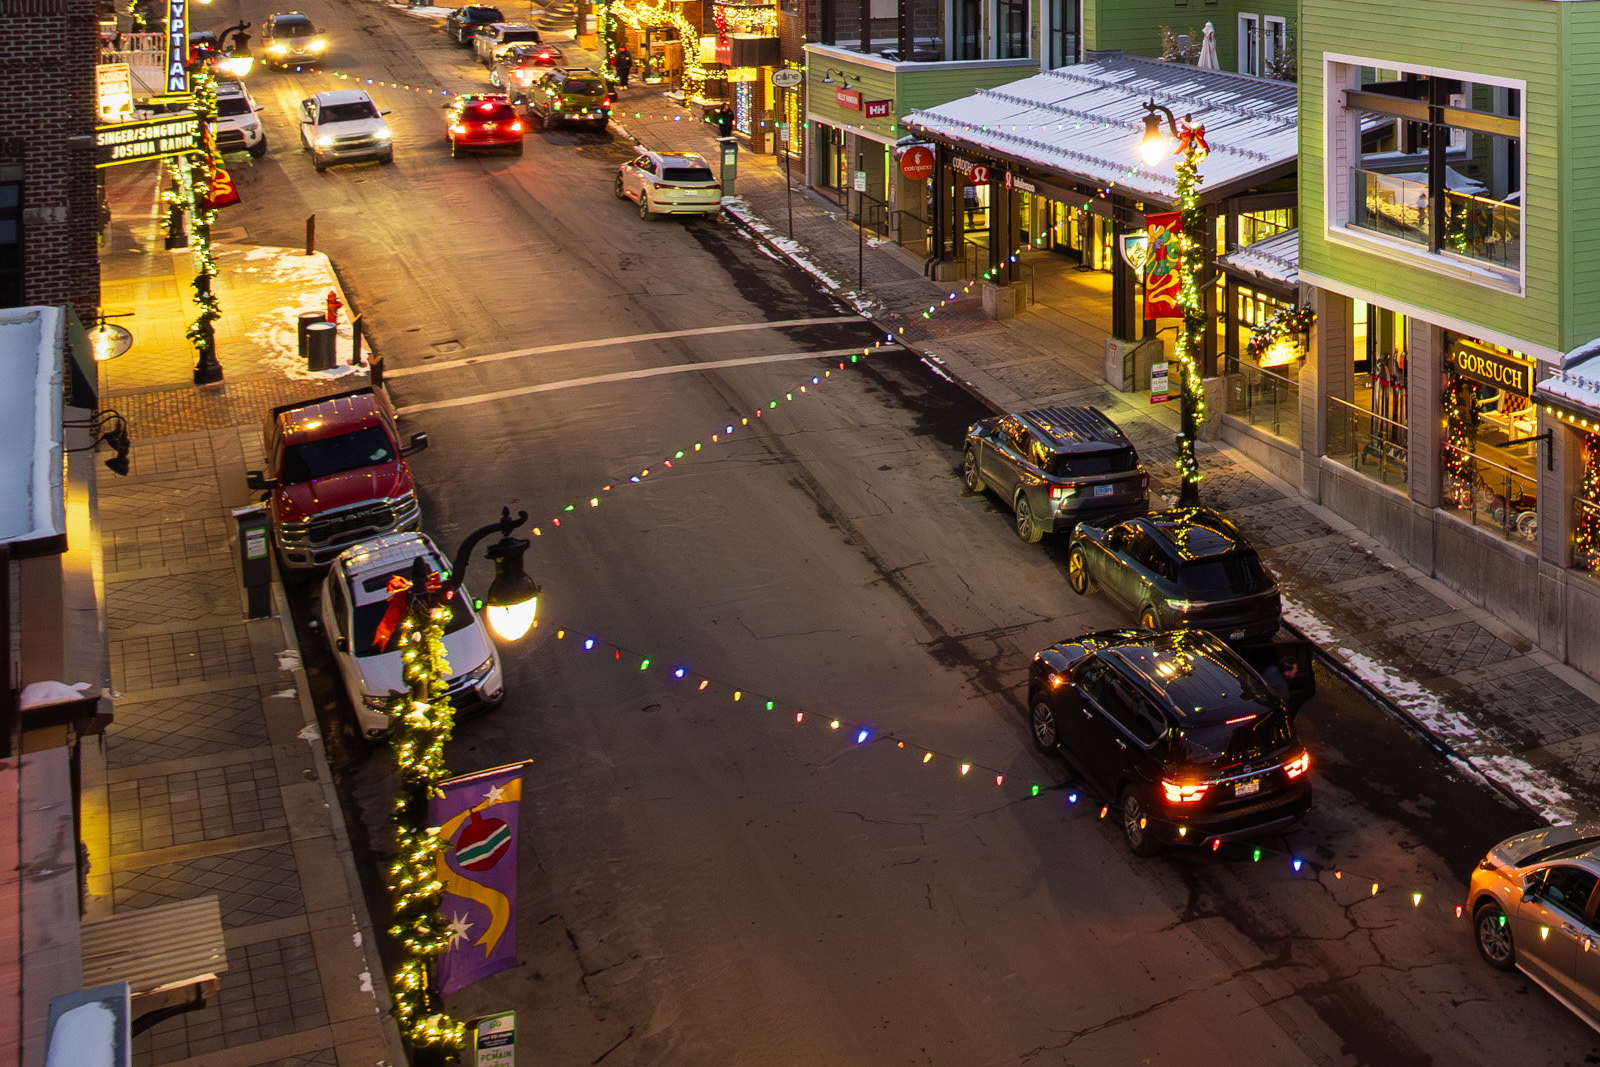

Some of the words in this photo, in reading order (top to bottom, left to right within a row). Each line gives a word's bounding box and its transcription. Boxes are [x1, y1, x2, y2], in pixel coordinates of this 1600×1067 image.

[869, 104, 886, 115] HH
[112, 142, 156, 159] JOSHUA
[160, 135, 194, 152] RADIN
[904, 164, 932, 172] cotopaxi
[1458, 350, 1523, 390] GORSUCH
